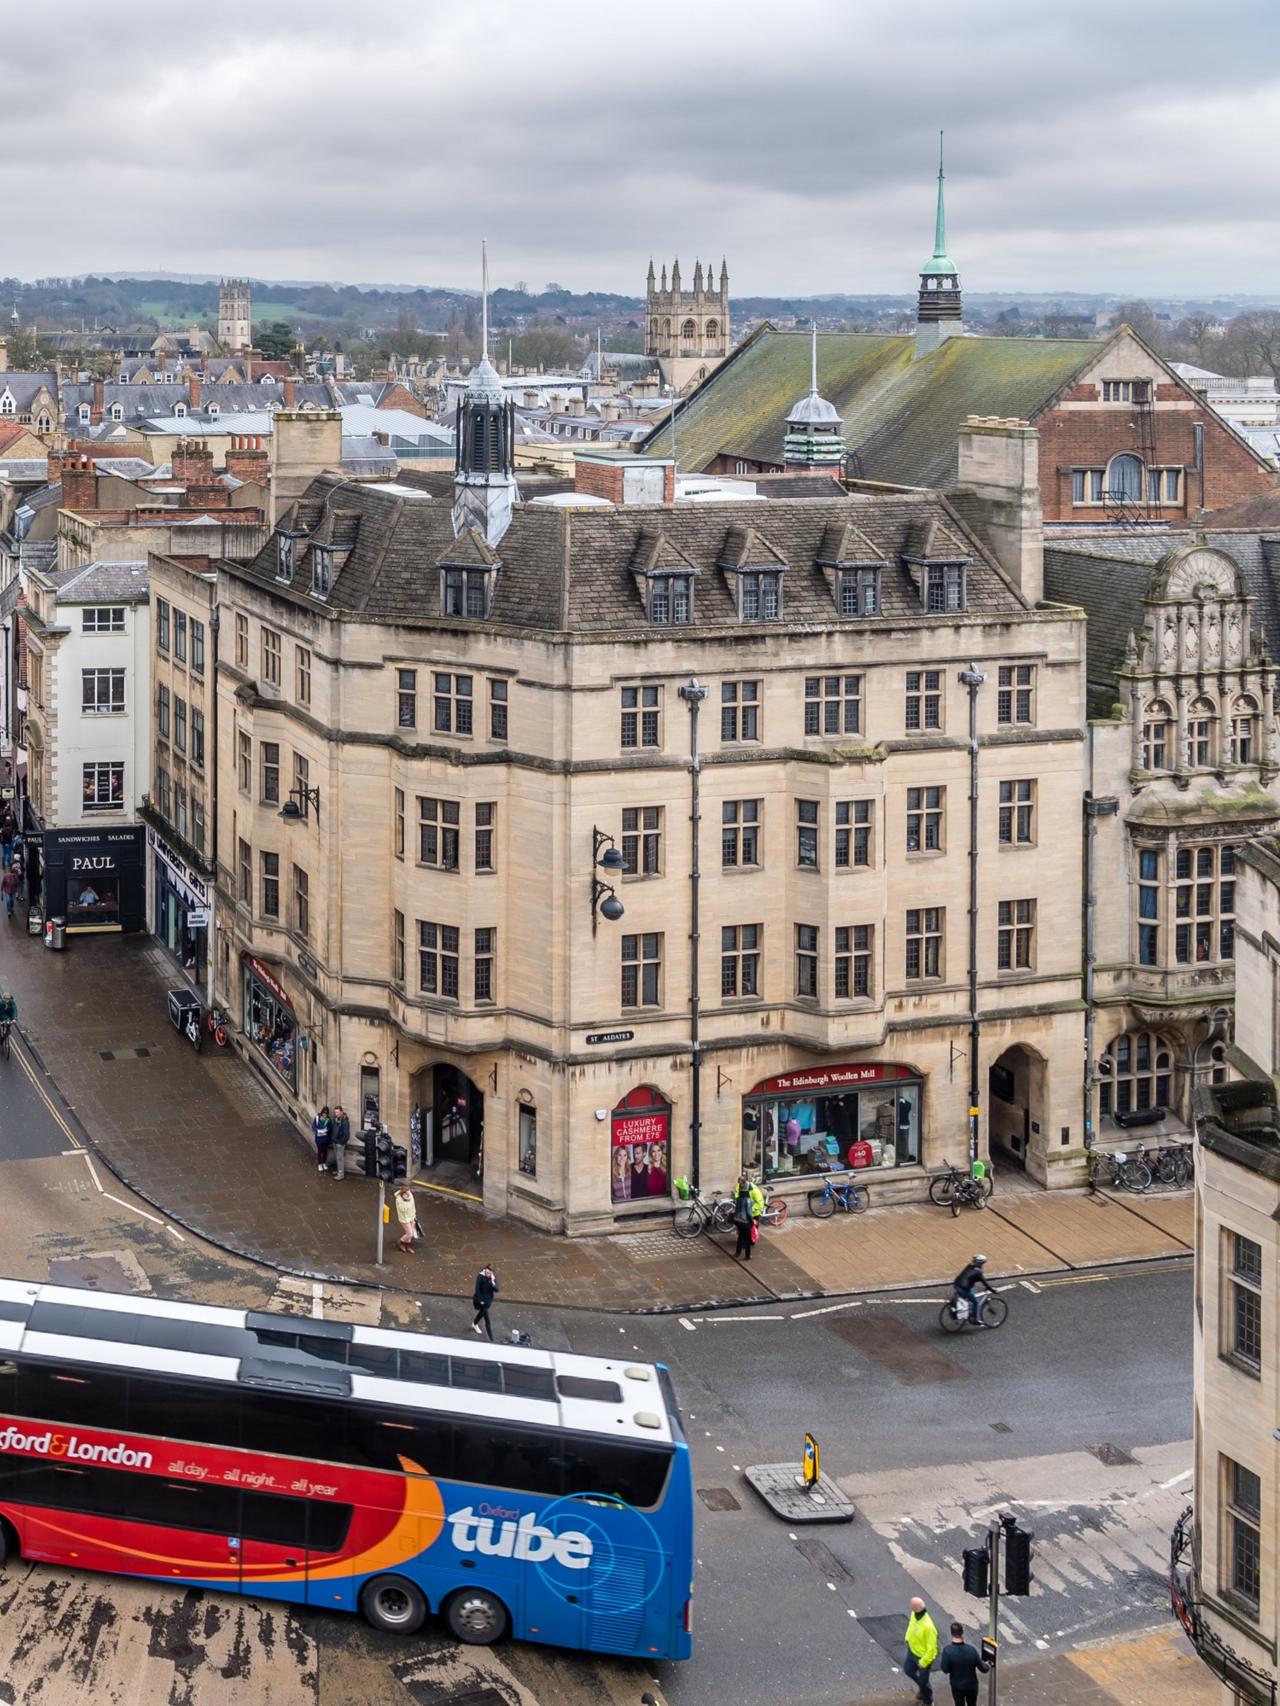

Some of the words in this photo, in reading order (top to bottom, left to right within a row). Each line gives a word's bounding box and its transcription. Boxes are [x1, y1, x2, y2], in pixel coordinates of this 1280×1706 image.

[72, 857, 115, 870] PAUL
[777, 1079, 791, 1087] The
[792, 1074, 829, 1086] Edinburgh
[830, 1072, 858, 1081] Woollen
[860, 1069, 875, 1079] Mill
[616, 1124, 663, 1137] CASHMERE
[623, 1118, 657, 1129] LUXURY
[619, 1134, 643, 1143] FROM
[645, 1131, 661, 1140] £75
[168, 1460, 185, 1474] all
[223, 1468, 239, 1482] all
[290, 1479, 308, 1492] all
[308, 1483, 339, 1496] year
[478, 1502, 519, 1520] Oxford
[447, 1506, 594, 1569] tube
